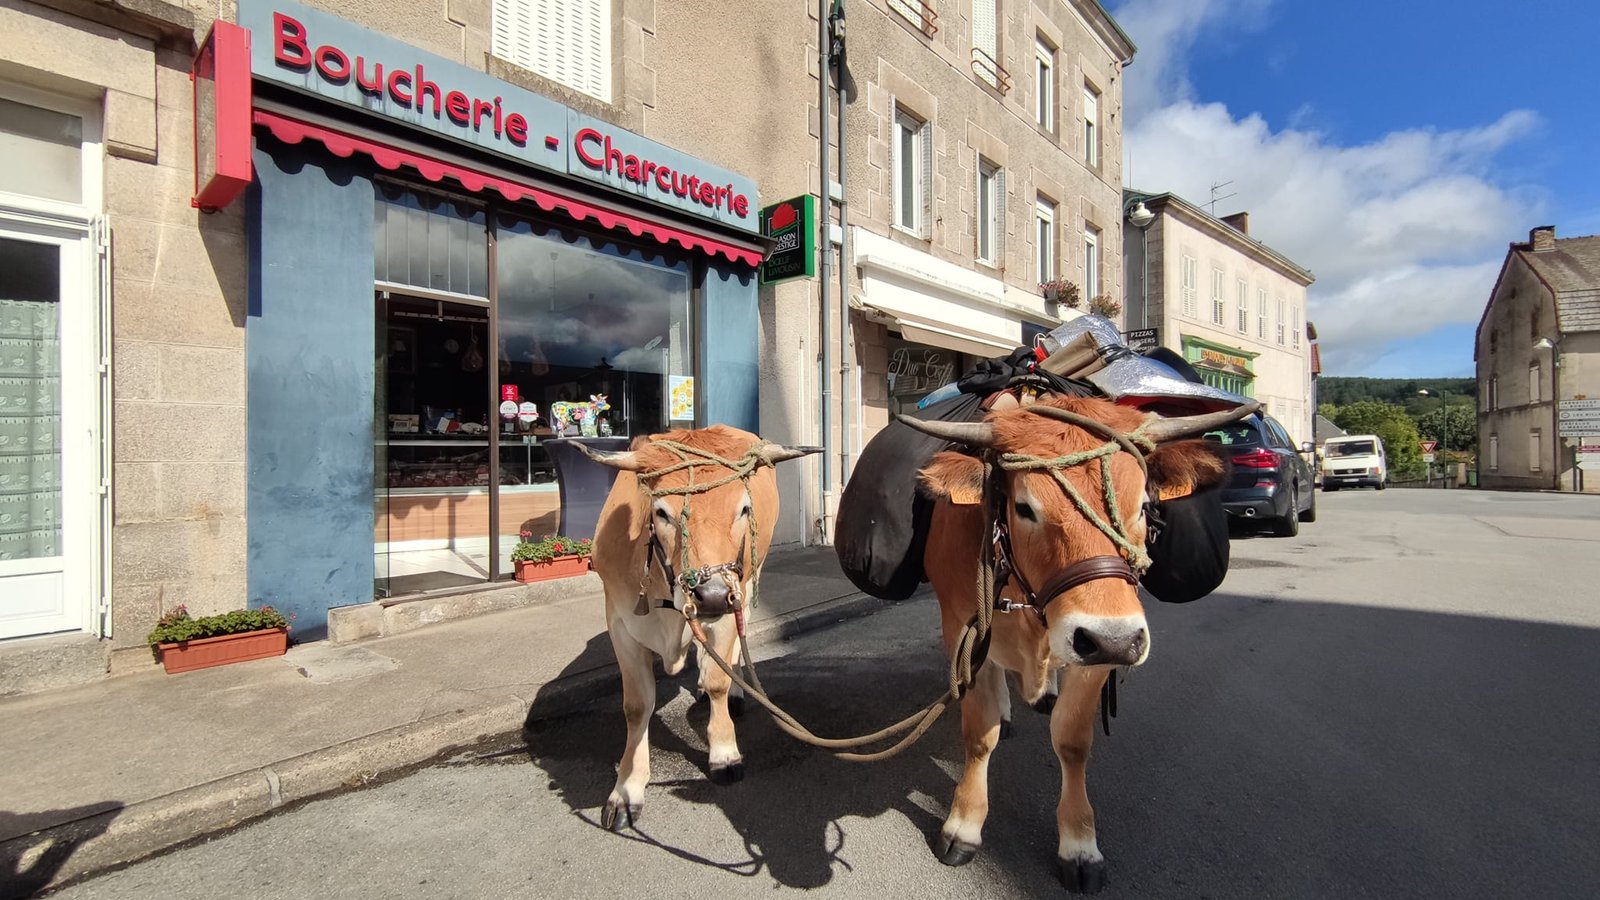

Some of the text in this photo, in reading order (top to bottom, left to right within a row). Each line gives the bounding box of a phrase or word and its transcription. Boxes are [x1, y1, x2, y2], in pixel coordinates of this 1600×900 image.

[273, 11, 528, 146] Boucherie
[575, 128, 749, 218] Charcuterie
[774, 239, 797, 251] RESTIGE
[1130, 329, 1153, 338] PIZZAS
[888, 347, 919, 377] Duo
